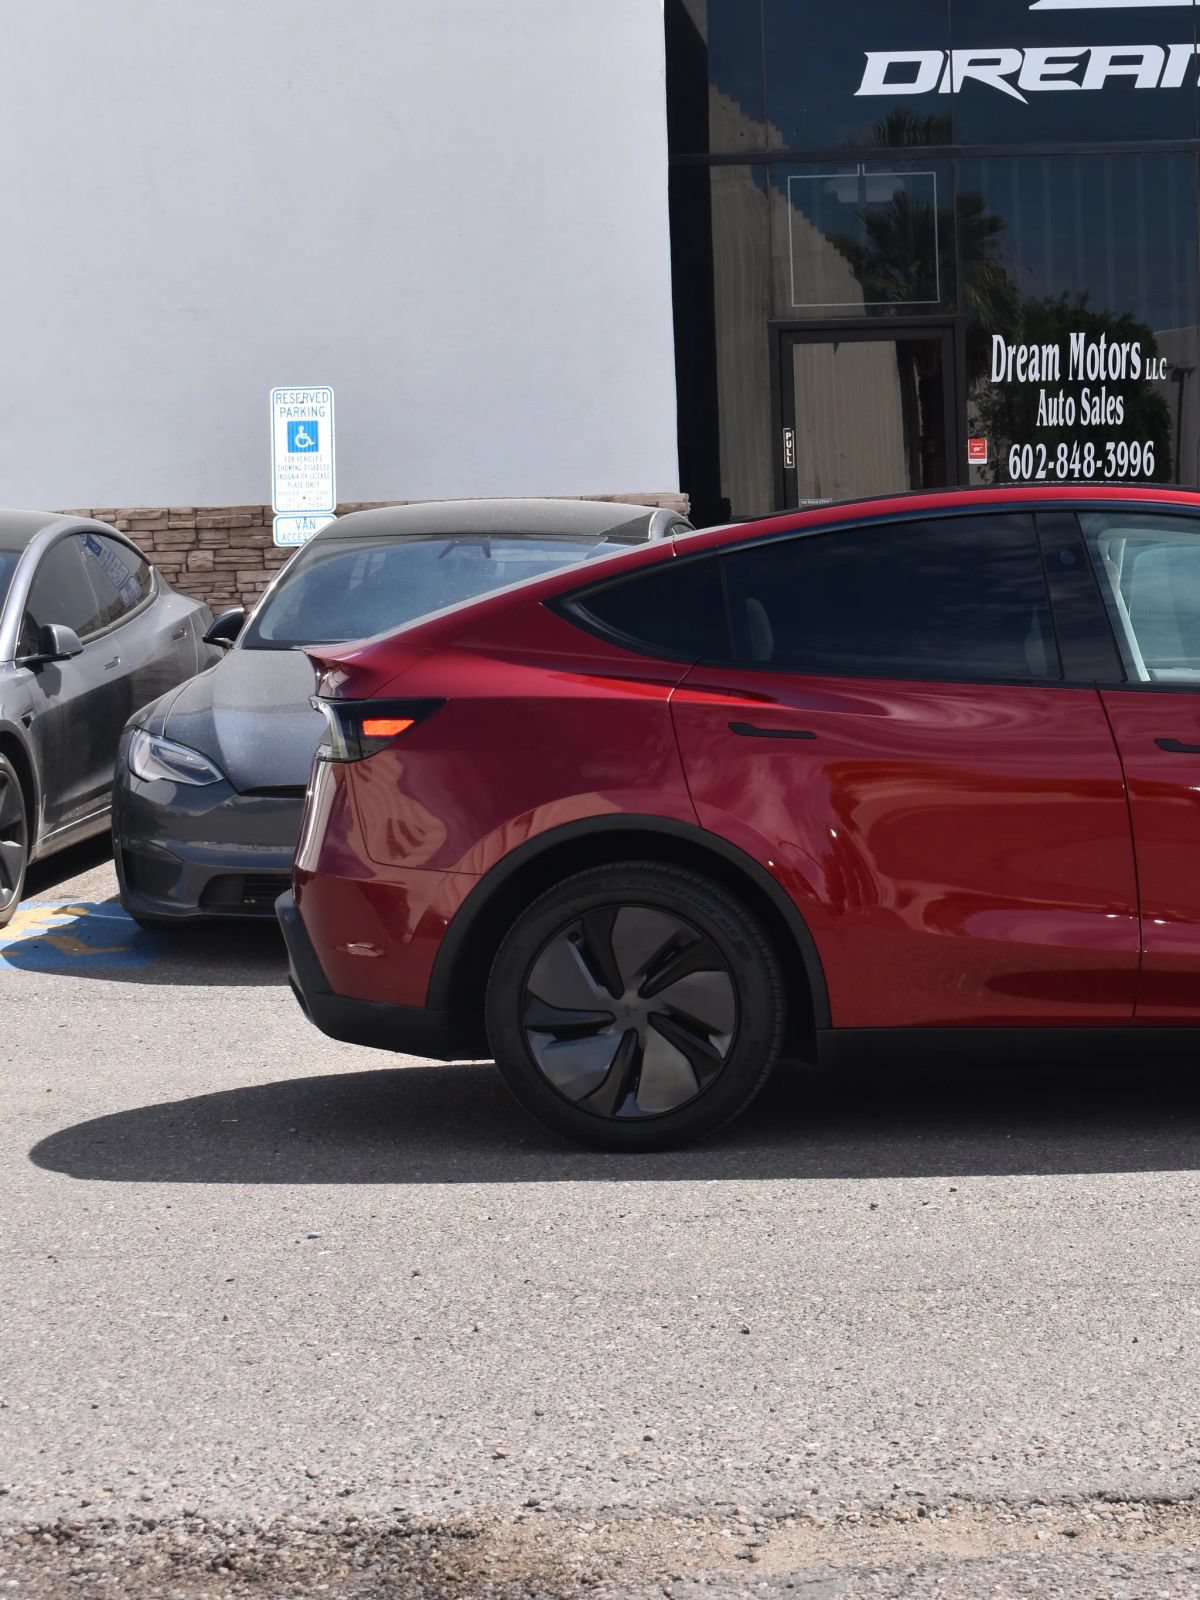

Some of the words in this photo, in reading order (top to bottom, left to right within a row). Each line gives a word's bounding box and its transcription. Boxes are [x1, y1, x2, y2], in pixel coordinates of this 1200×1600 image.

[991, 335, 1060, 382] Dream
[1069, 332, 1141, 380] Motors
[1145, 357, 1167, 380] LLC
[276, 392, 329, 404] RESERVED
[1036, 388, 1075, 426] Auto
[1080, 386, 1124, 425] Sales
[280, 406, 326, 418] PARKING
[1009, 440, 1154, 479] 602-848-3996
[296, 519, 316, 530] VAN
